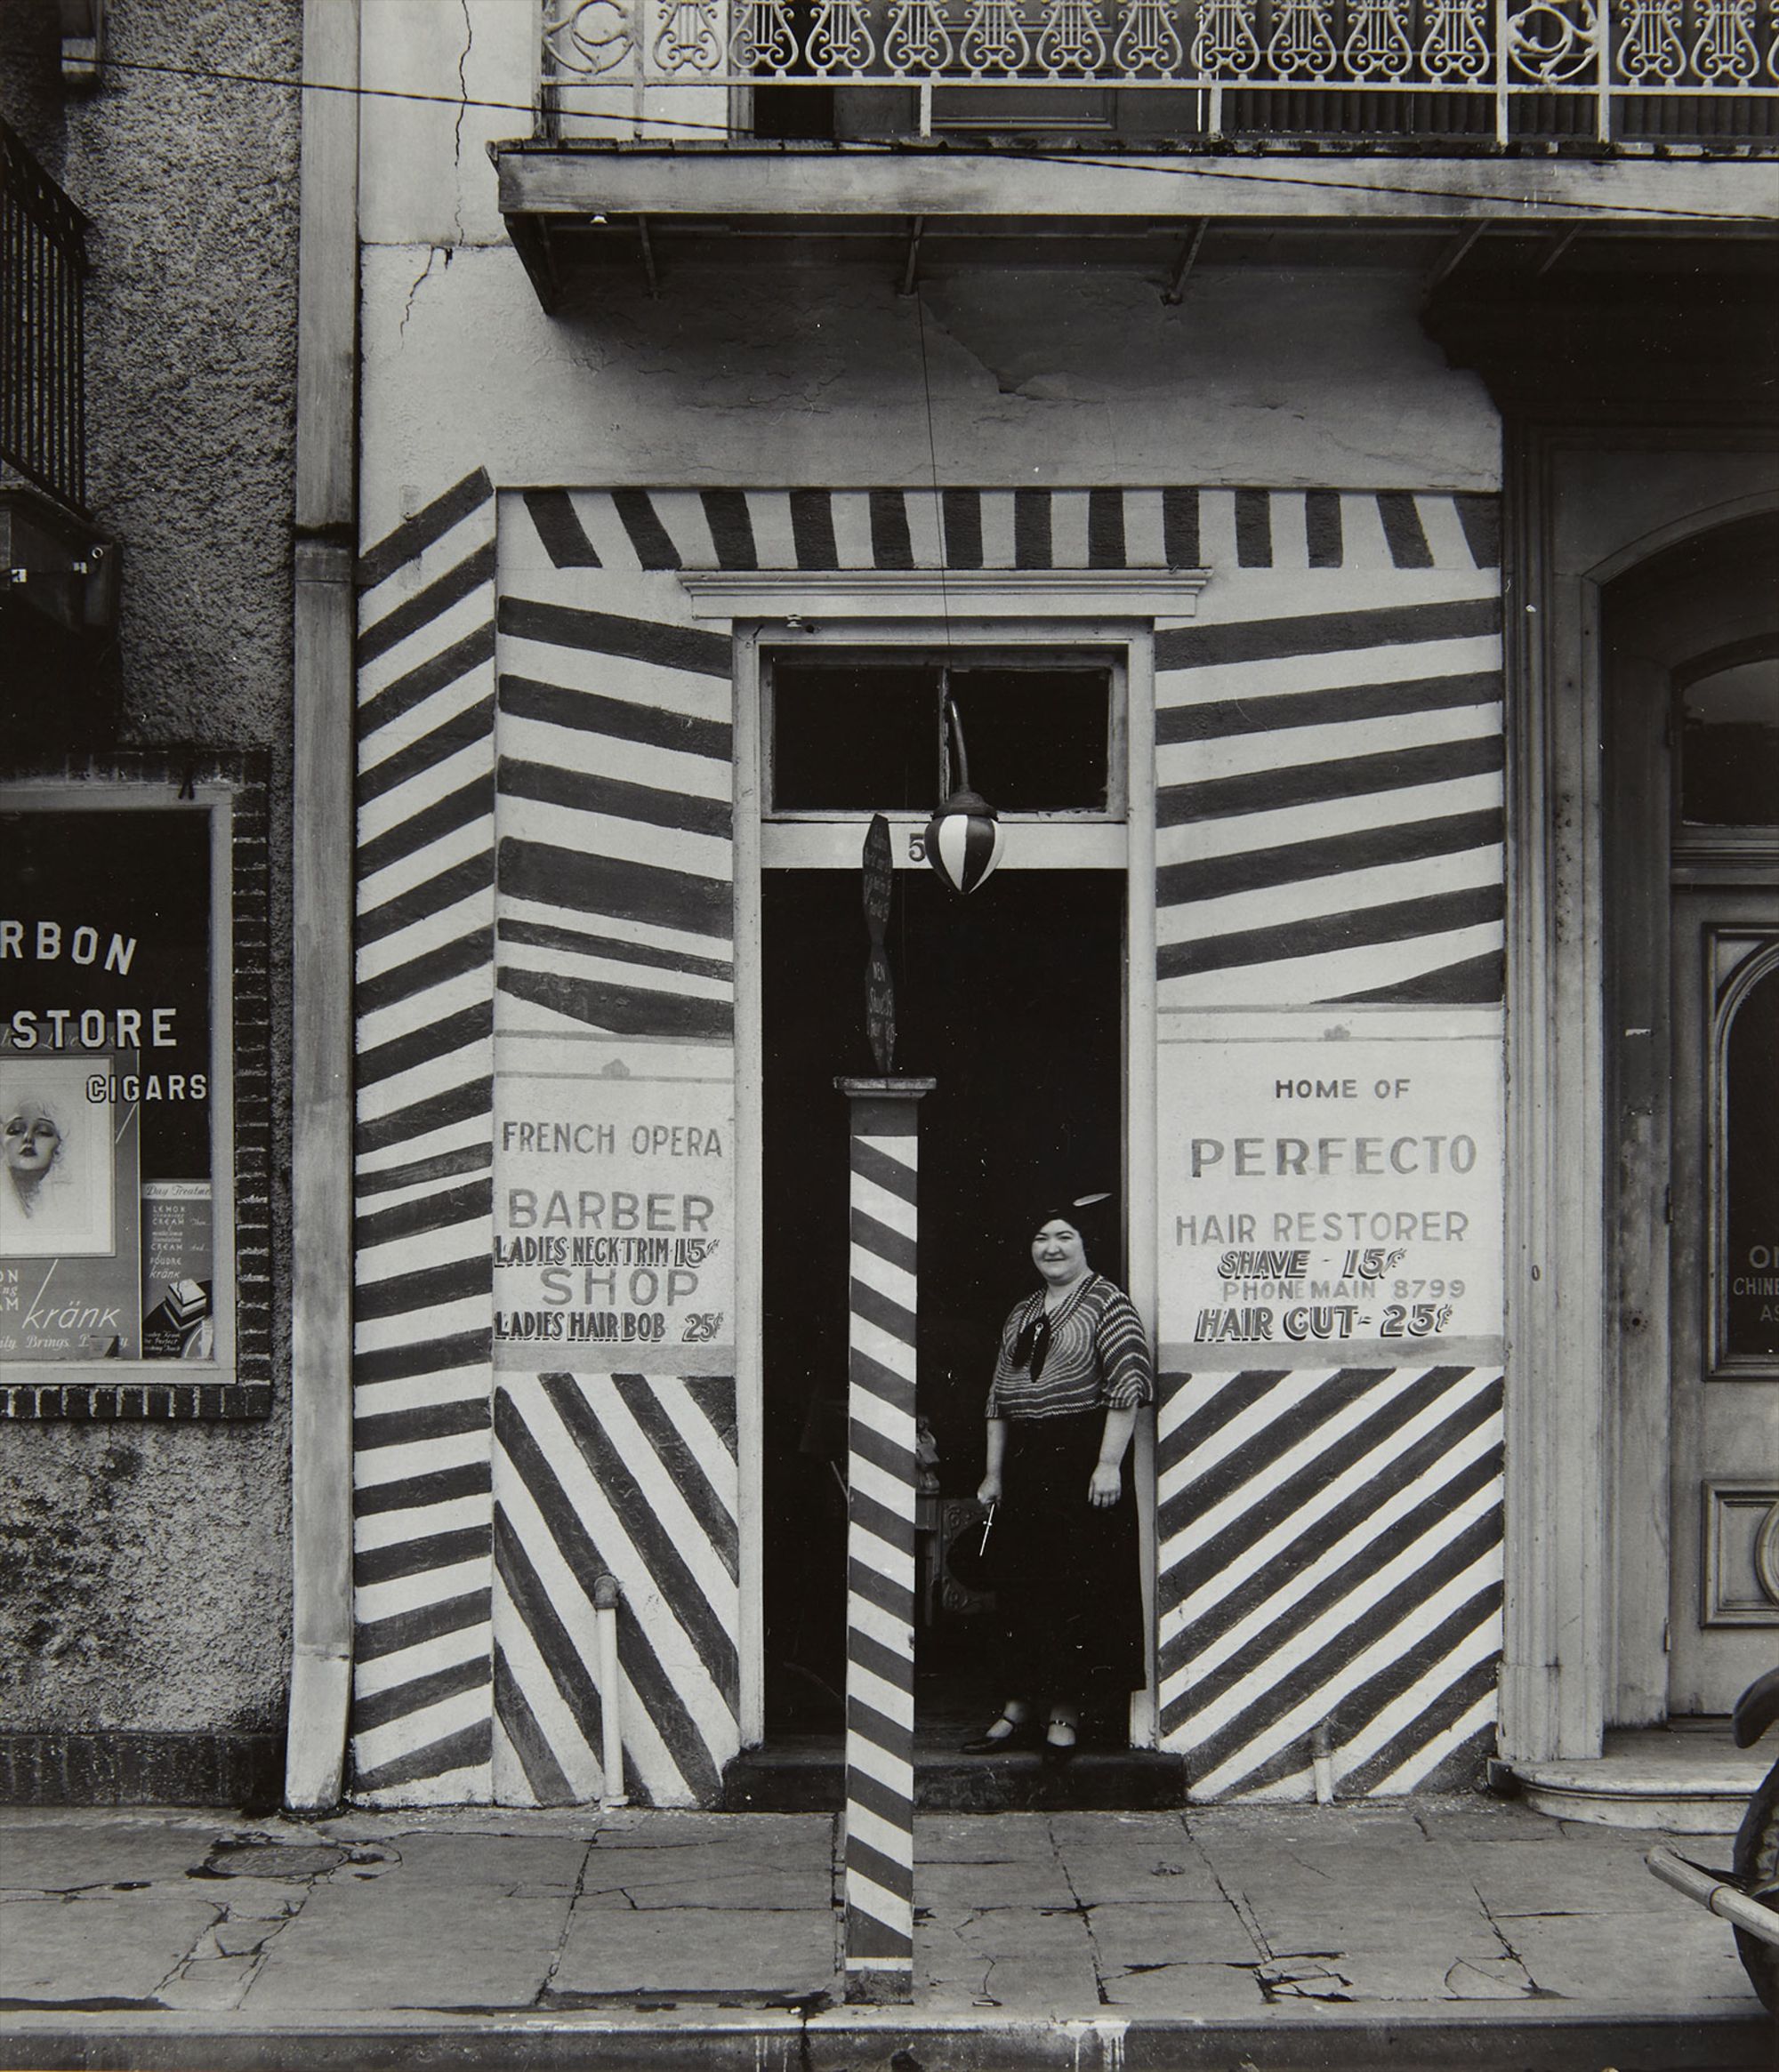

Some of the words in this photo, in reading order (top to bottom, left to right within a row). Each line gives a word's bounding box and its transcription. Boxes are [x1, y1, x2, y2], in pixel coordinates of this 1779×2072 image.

[0, 920, 136, 976] RBON
[12, 1008, 177, 1049] STORE
[87, 1074, 206, 1102] CIGARS
[1275, 1080, 1357, 1098] HOME
[1374, 1079, 1411, 1098] OF
[503, 1121, 615, 1154] FRENCH
[632, 1125, 723, 1157] OPERA
[1191, 1135, 1477, 1177] PERFECTO
[508, 1188, 714, 1232] BARBER
[1176, 1213, 1256, 1245] HAIR
[1274, 1211, 1469, 1242] RESTORER
[494, 1235, 568, 1267] LADIES
[1217, 1250, 1310, 1280] SHAVE
[1342, 1248, 1407, 1280] 15¢
[540, 1266, 699, 1306] SHOP
[1223, 1281, 1305, 1302] PHONE
[1310, 1280, 1376, 1298] MAIN
[1394, 1279, 1466, 1299] 8799
[22, 1289, 120, 1329] kränk
[1194, 1306, 1274, 1343] HAIR
[1381, 1304, 1453, 1337] 25¢
[25, 1335, 71, 1352] Brings
[494, 1312, 565, 1340] LADIES
[568, 1312, 618, 1342] HAIR
[621, 1312, 666, 1342] BOB
